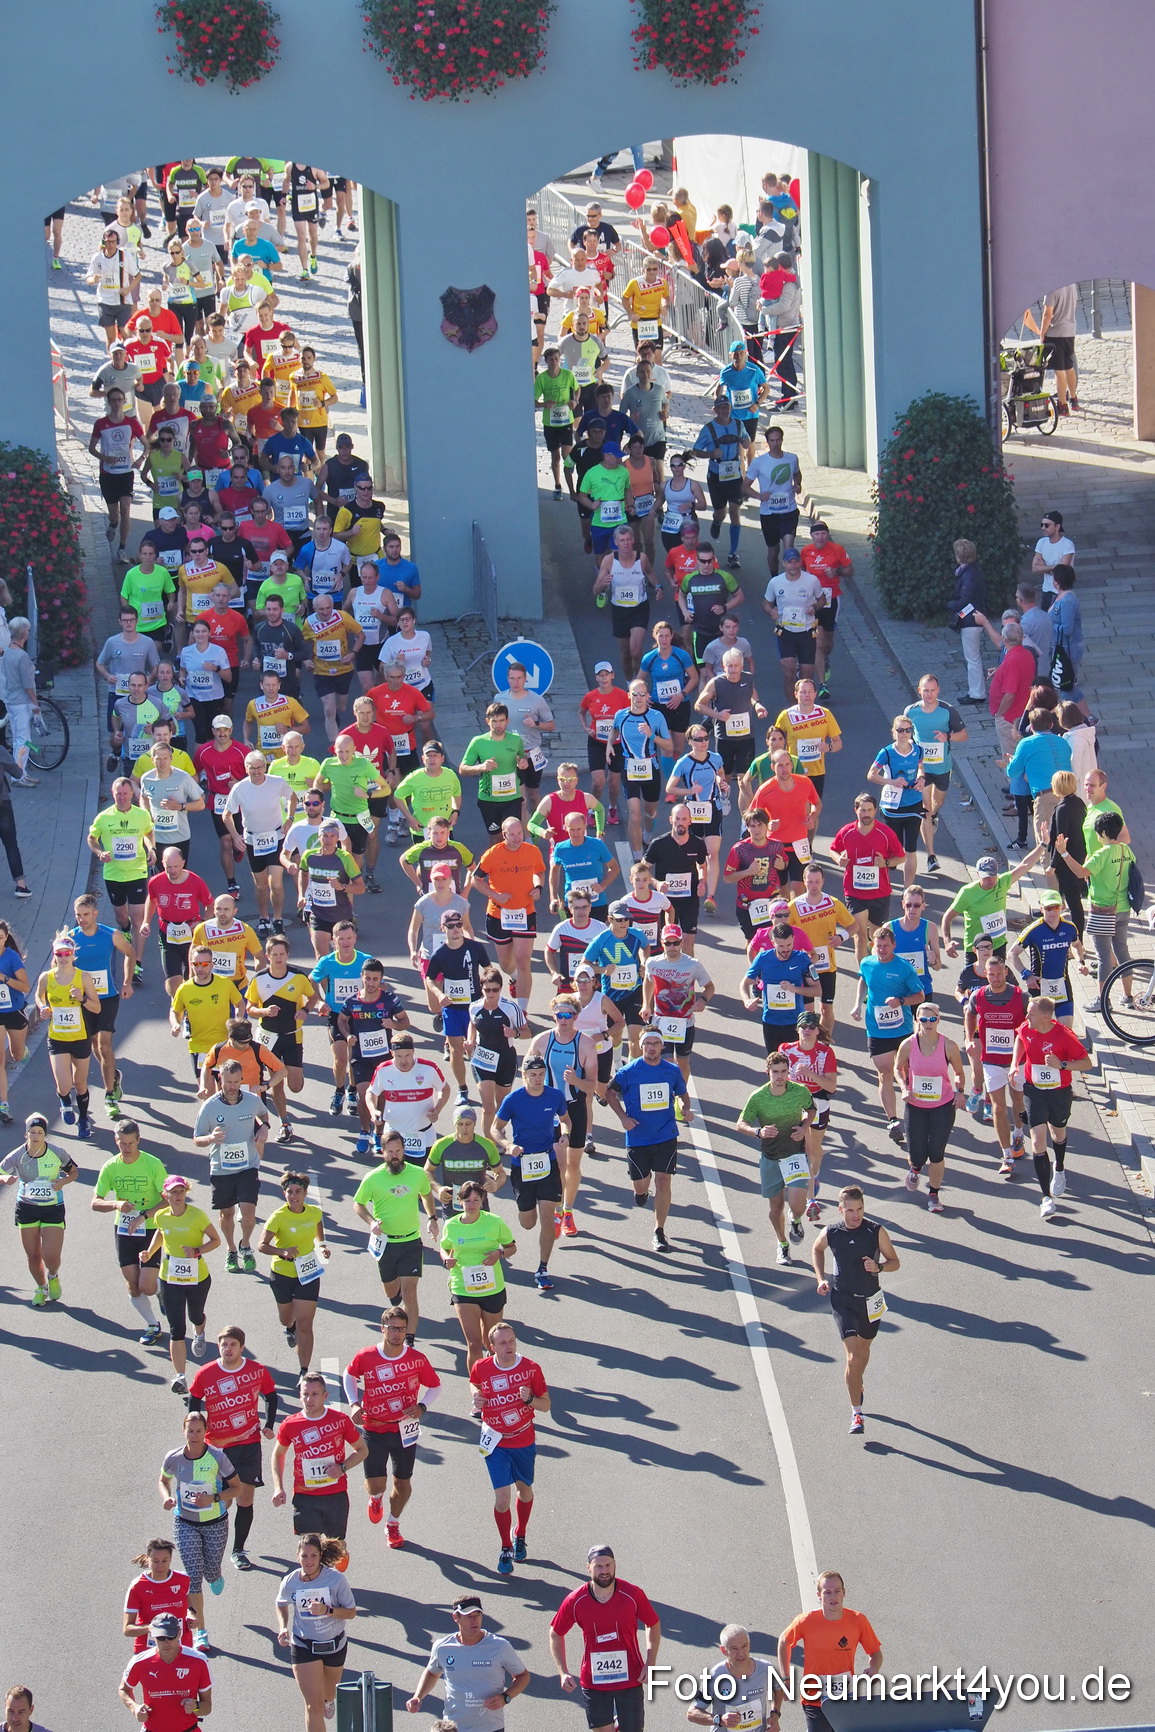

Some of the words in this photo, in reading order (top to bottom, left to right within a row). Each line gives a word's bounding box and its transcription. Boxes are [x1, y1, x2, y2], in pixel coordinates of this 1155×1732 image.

[161, 480, 177, 489] 2198
[638, 500, 653, 508] 2205
[286, 511, 303, 519] 3126
[665, 517, 680, 525] 2957
[203, 570, 219, 578] BÖGL
[691, 584, 721, 593] BOCK
[320, 645, 338, 653] 2423
[266, 662, 282, 670] 2561
[405, 670, 421, 680] 2275
[660, 686, 678, 695] 2119
[258, 711, 272, 719] MAX
[792, 724, 808, 732] MAX
[810, 718, 828, 727] BÖGL
[256, 837, 275, 846] 2514
[116, 843, 134, 851] 2290
[856, 872, 876, 880] 2429
[669, 879, 688, 888] 2354
[314, 889, 331, 897] 2525
[755, 904, 768, 913] 127
[800, 915, 817, 924] MAX
[819, 909, 836, 918] BÖGL
[208, 939, 225, 947] MAX
[227, 934, 246, 943] BÖGL
[1042, 942, 1069, 950] BOCK
[213, 958, 231, 966] 2421
[617, 972, 632, 980] 173
[338, 985, 359, 993] 2115
[450, 986, 464, 994] 249
[776, 992, 786, 1000] 43
[59, 1014, 74, 1022] 142
[352, 1011, 389, 1019] MENSCH
[879, 1010, 899, 1020] 2479
[666, 1024, 678, 1033] 42
[364, 1037, 384, 1048] 3066
[990, 1035, 1010, 1044] 3060
[477, 1048, 495, 1061] 3062
[1040, 1071, 1051, 1080] 96
[921, 1082, 933, 1091] 95
[647, 1090, 663, 1100] 319
[402, 1138, 422, 1148] 2320
[224, 1150, 245, 1160] 2263
[444, 1159, 484, 1169] BOCK
[528, 1160, 544, 1170] 130
[789, 1161, 800, 1171] 76
[30, 1188, 51, 1196] 2235
[175, 1264, 192, 1274] 294
[470, 1272, 488, 1283] 153
[310, 1465, 328, 1476] 112
[597, 1659, 622, 1671] 2442
